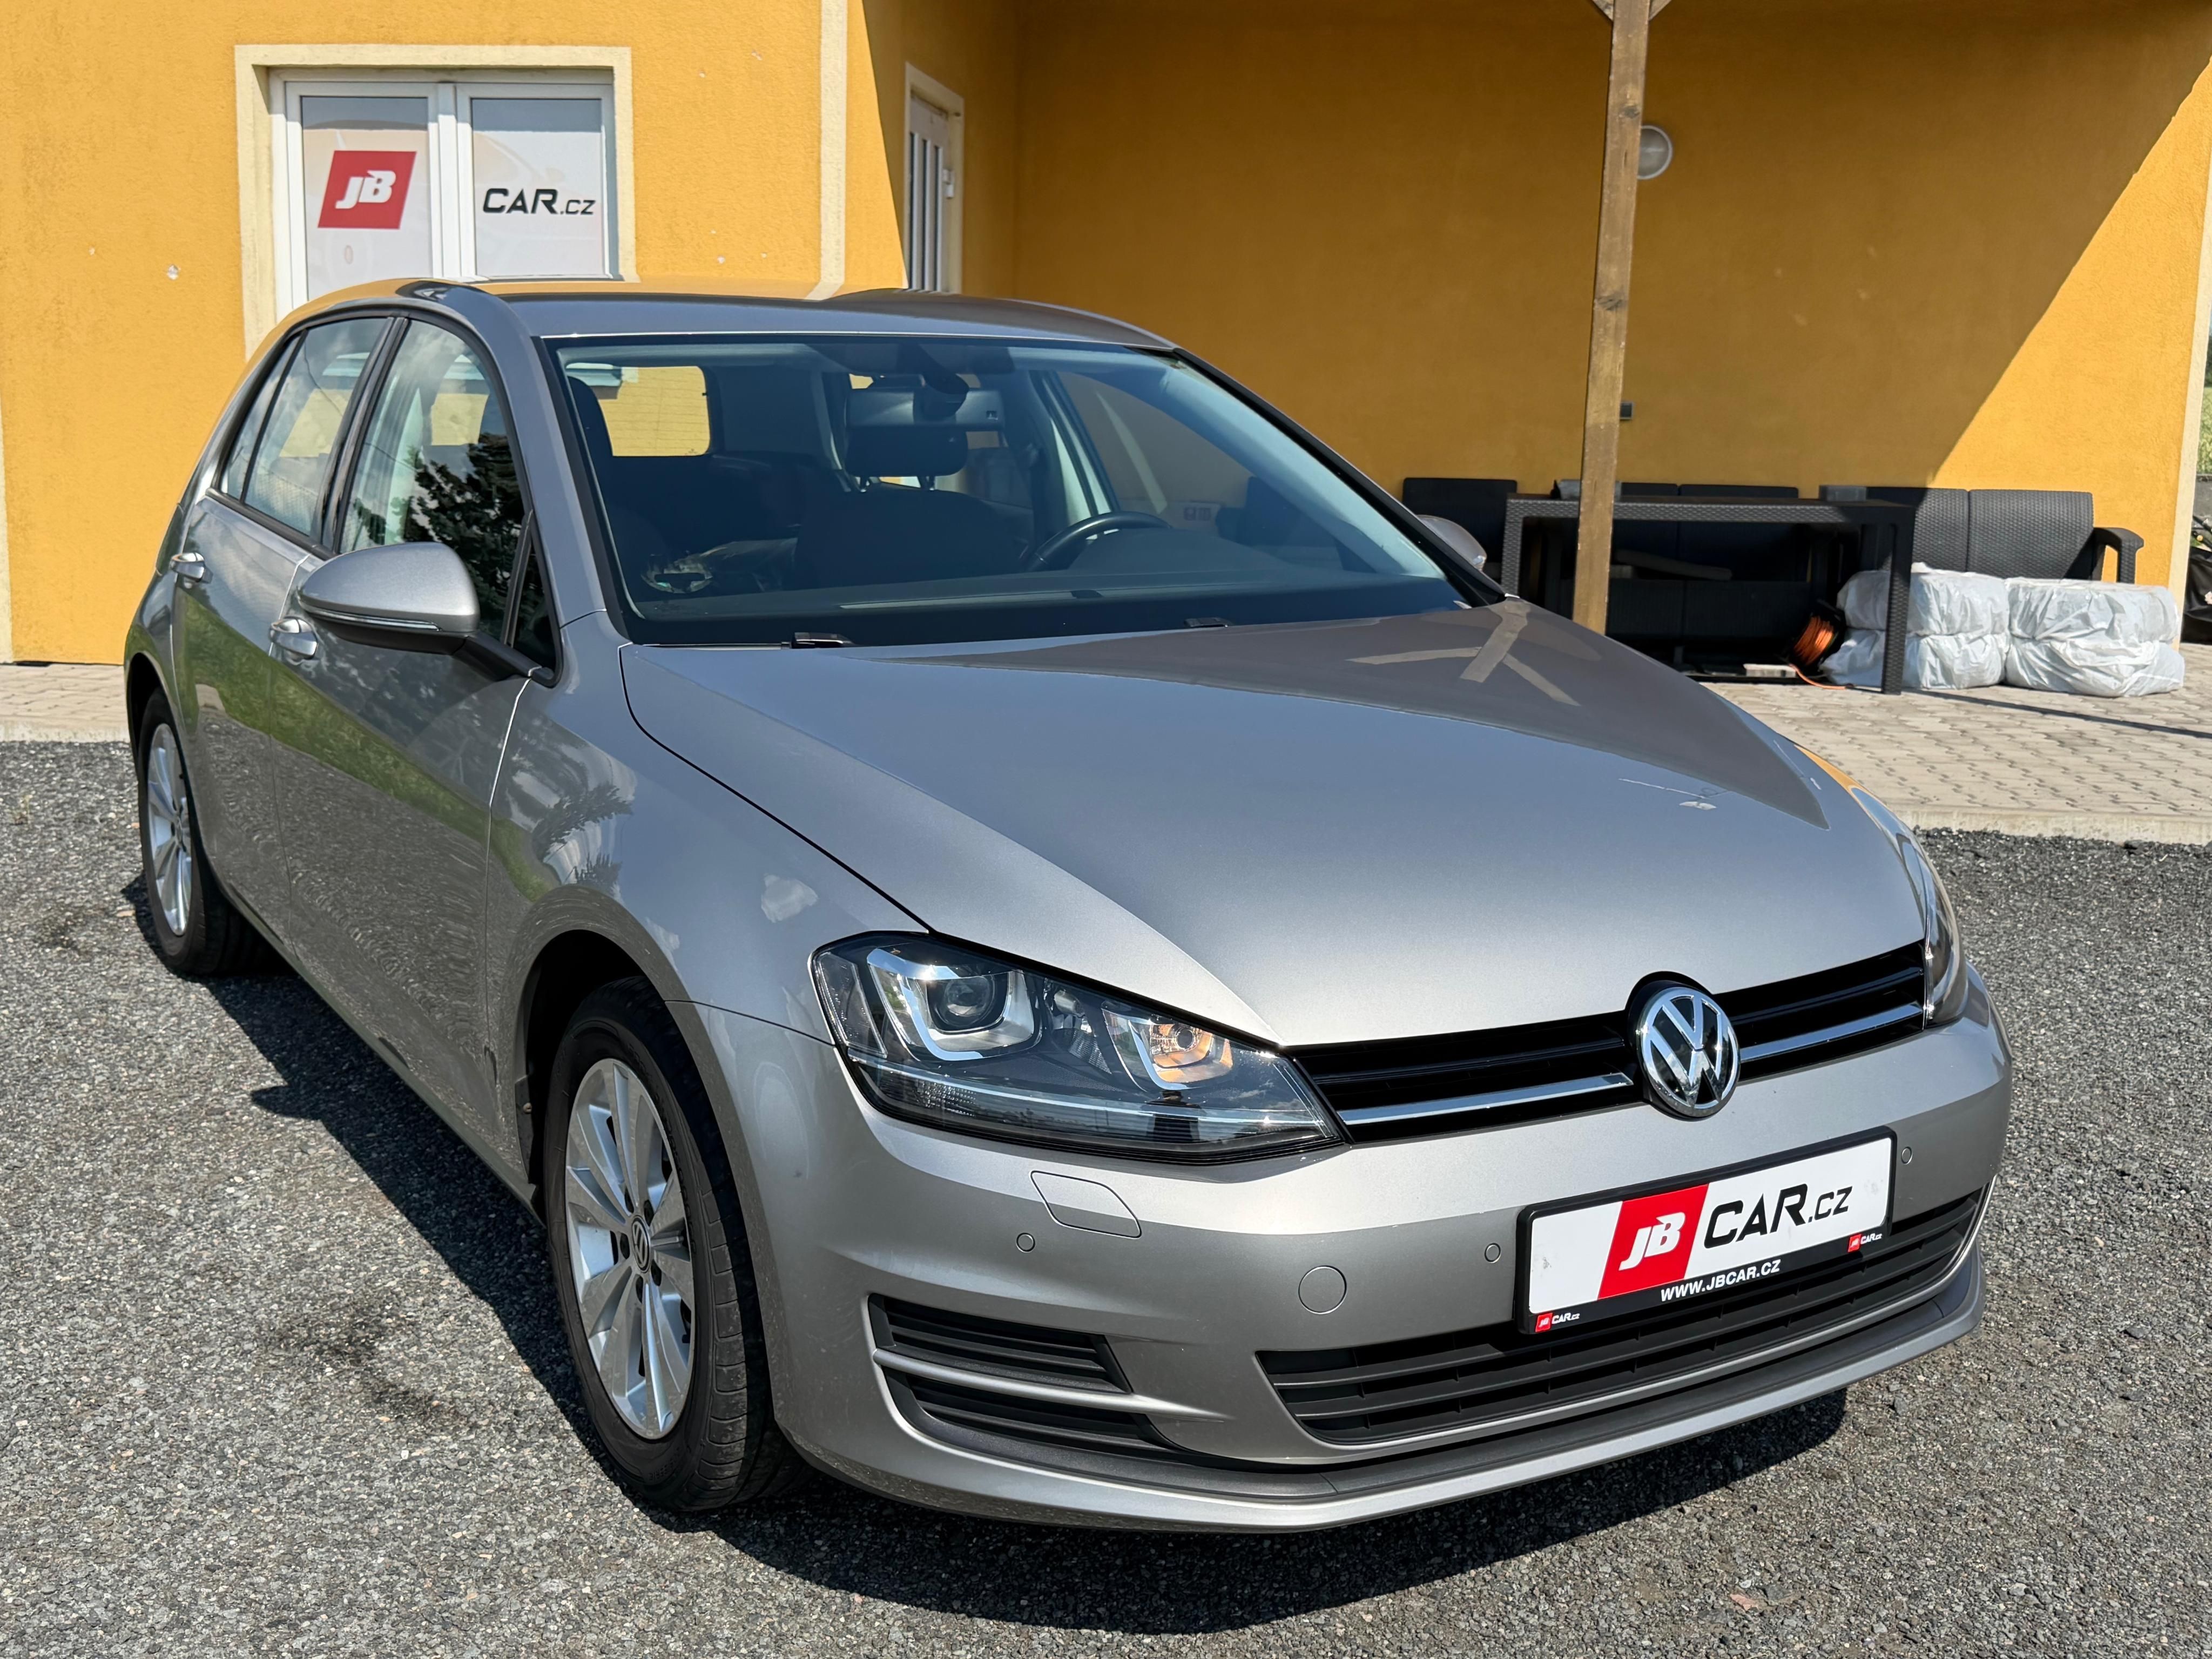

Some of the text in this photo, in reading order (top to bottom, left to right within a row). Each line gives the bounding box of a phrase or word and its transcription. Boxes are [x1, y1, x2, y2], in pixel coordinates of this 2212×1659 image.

[335, 170, 396, 210] JB
[1642, 987, 1738, 1117] VW
[1618, 1211, 1686, 1271] JB
[1661, 1259, 1781, 1302] WWW.JBCAR.CZ
